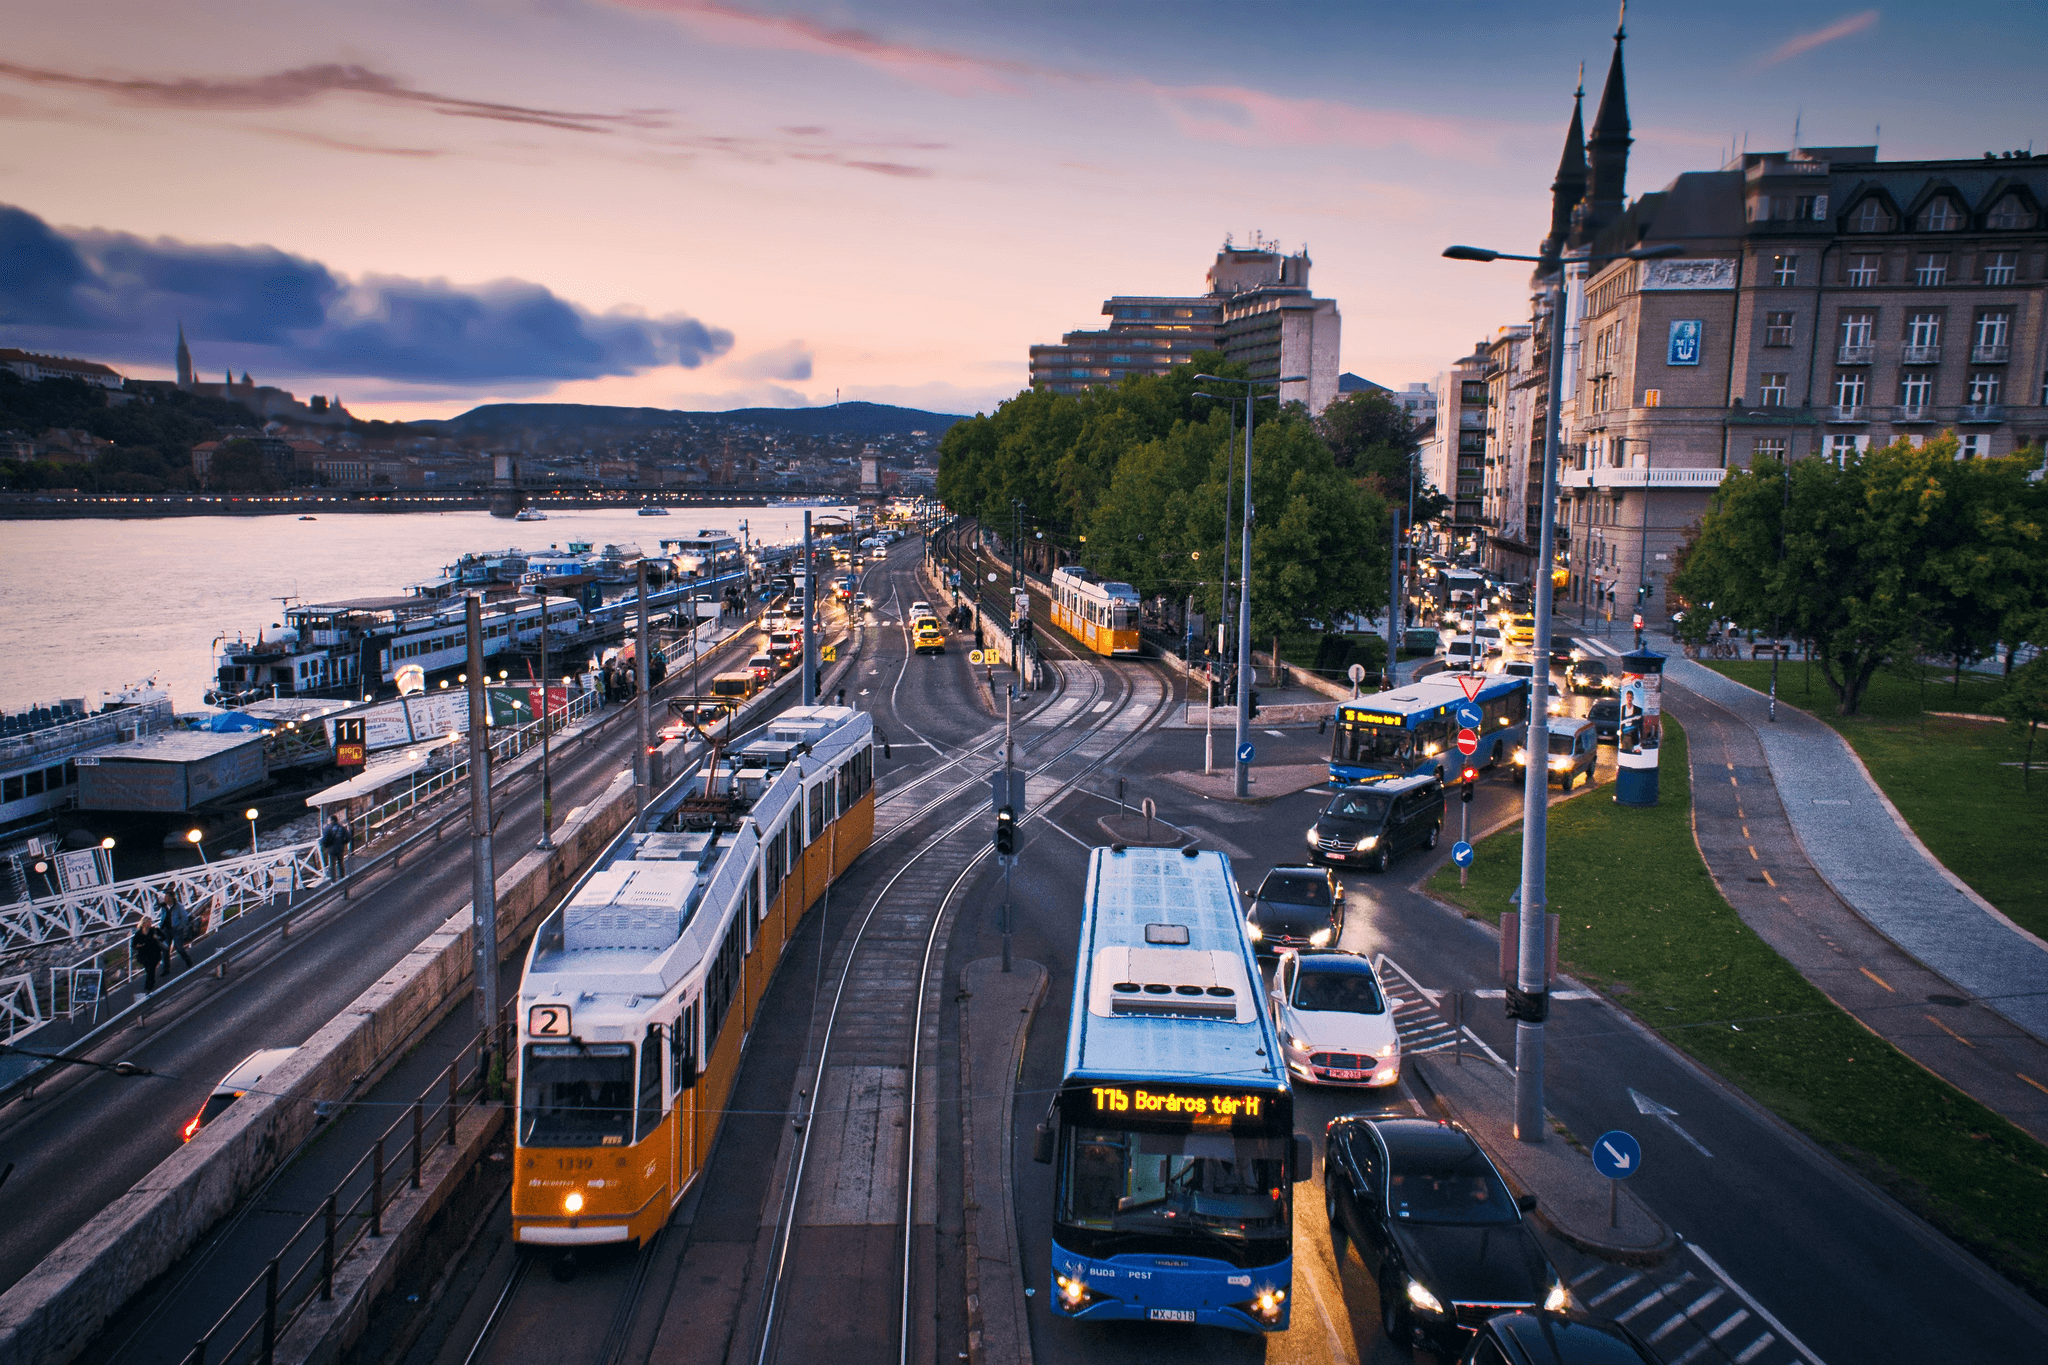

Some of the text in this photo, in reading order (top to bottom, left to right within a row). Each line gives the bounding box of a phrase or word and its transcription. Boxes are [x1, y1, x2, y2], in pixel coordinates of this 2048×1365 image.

[339, 720, 361, 741] 11
[68, 863, 94, 874] DOCK
[76, 872, 93, 887] 11
[540, 1009, 558, 1034] 2
[1092, 1087, 1260, 1116] 115 Boráros tér H
